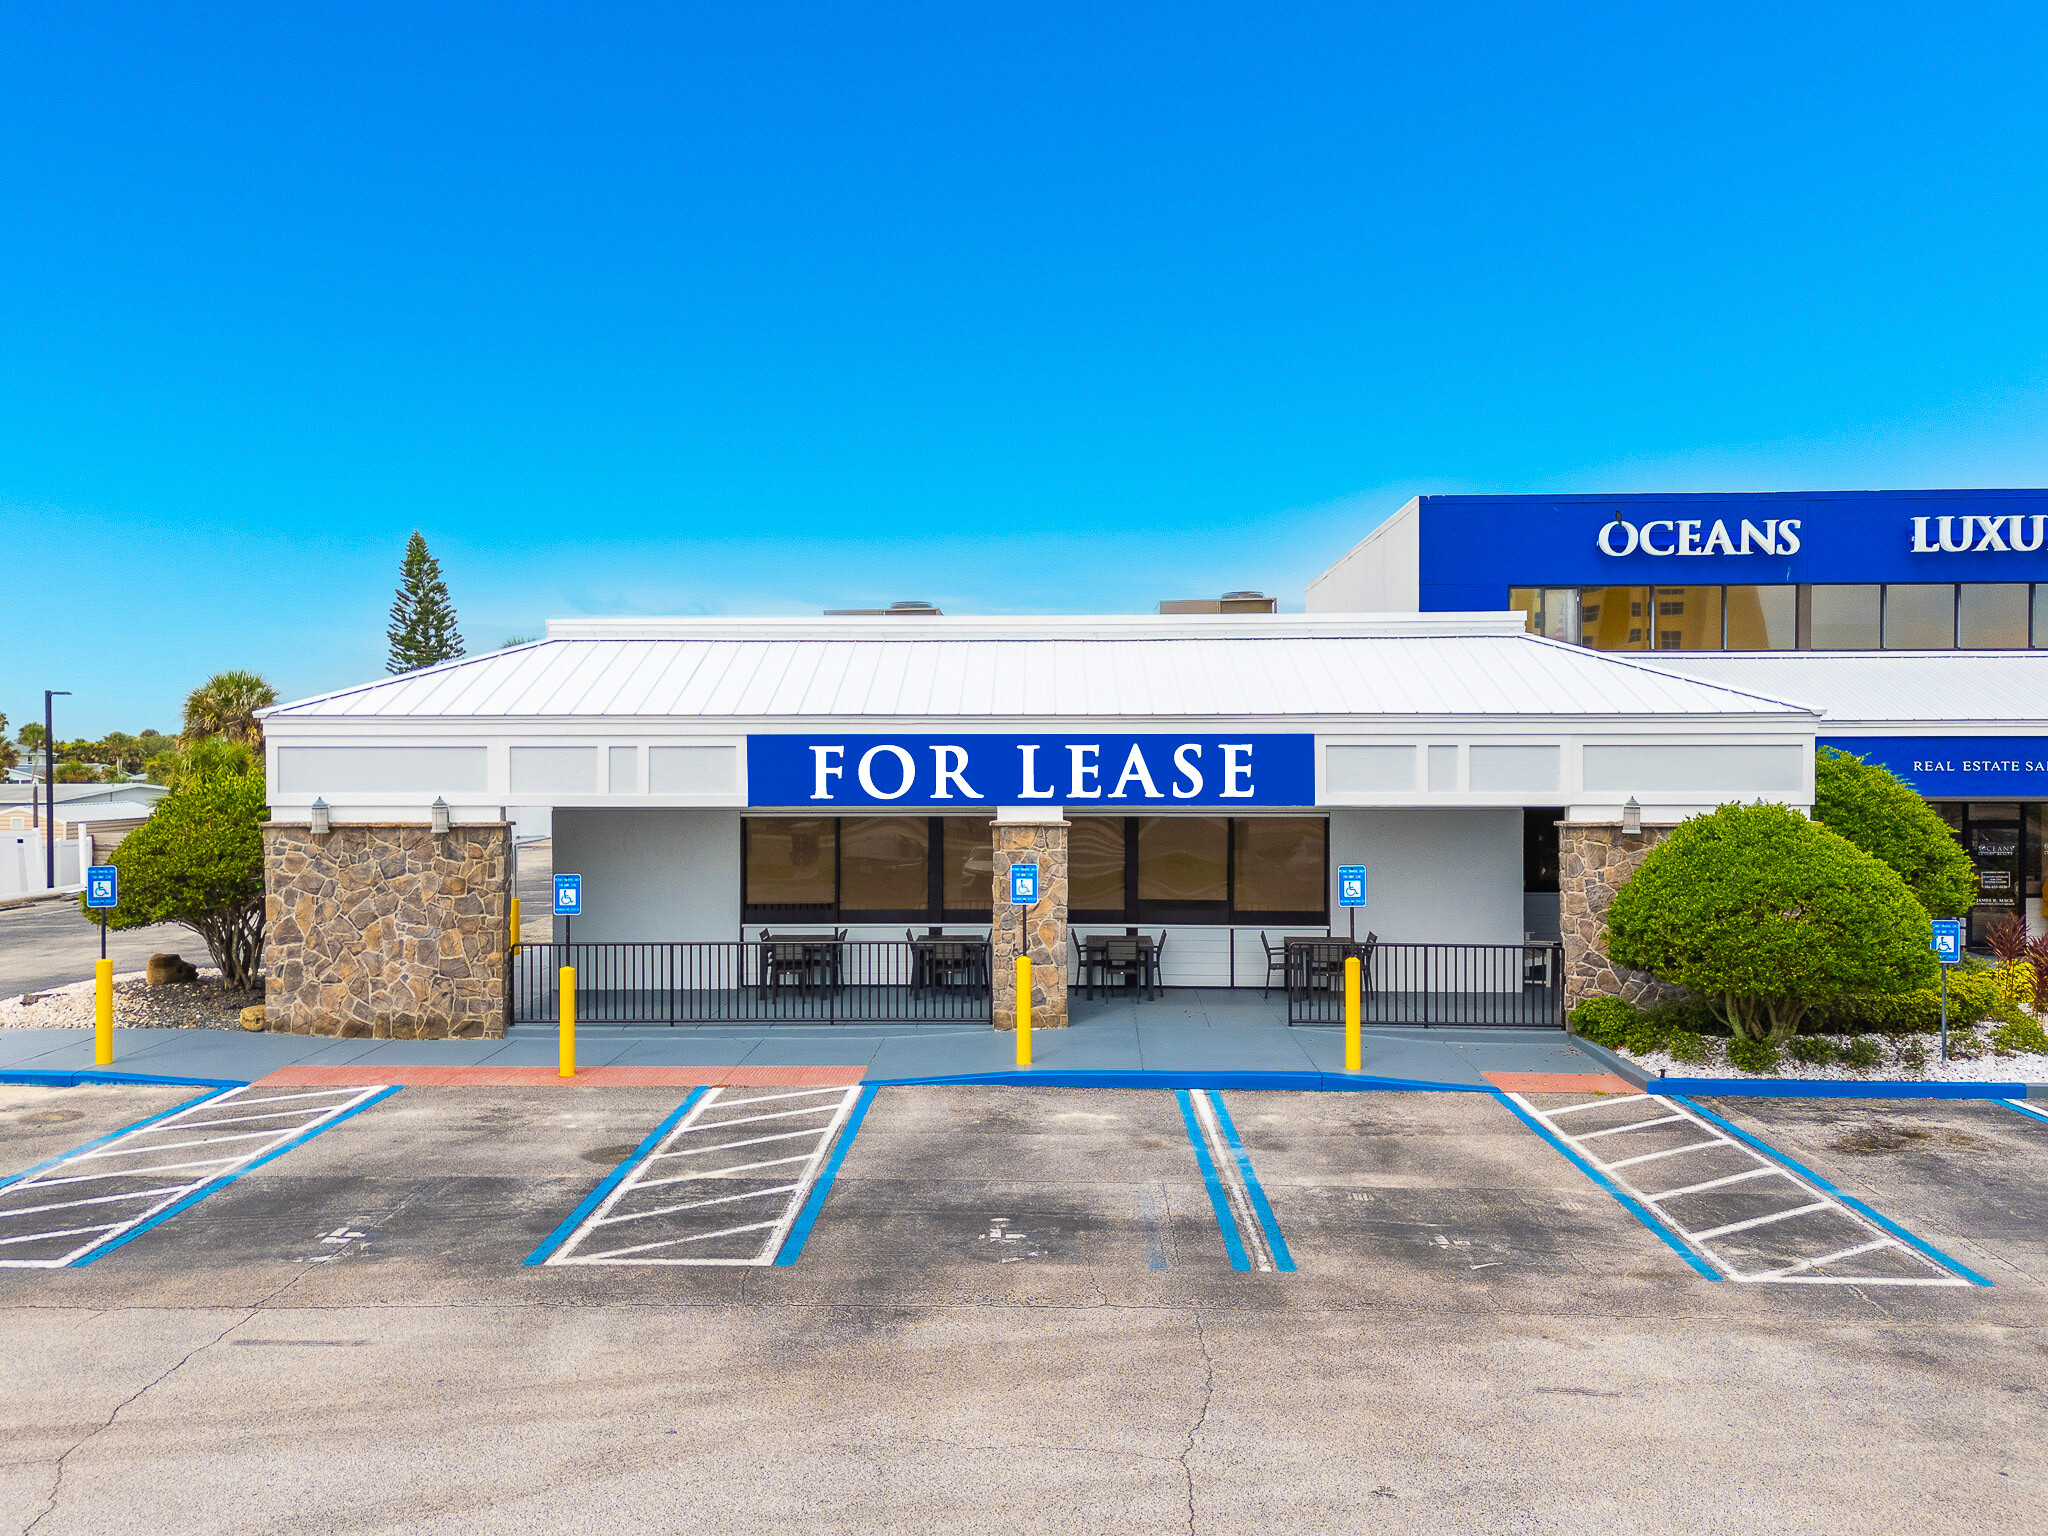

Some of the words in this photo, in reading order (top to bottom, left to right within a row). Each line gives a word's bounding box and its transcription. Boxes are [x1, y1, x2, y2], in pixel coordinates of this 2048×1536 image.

[1597, 519, 1802, 557] OCEANS
[1910, 514, 2048, 554] LUXU
[809, 744, 984, 801] FOR
[1017, 743, 1255, 800] LEASE
[1913, 760, 1955, 772] REAL
[1962, 760, 2020, 772] ESTATE
[2025, 760, 2048, 772] SA
